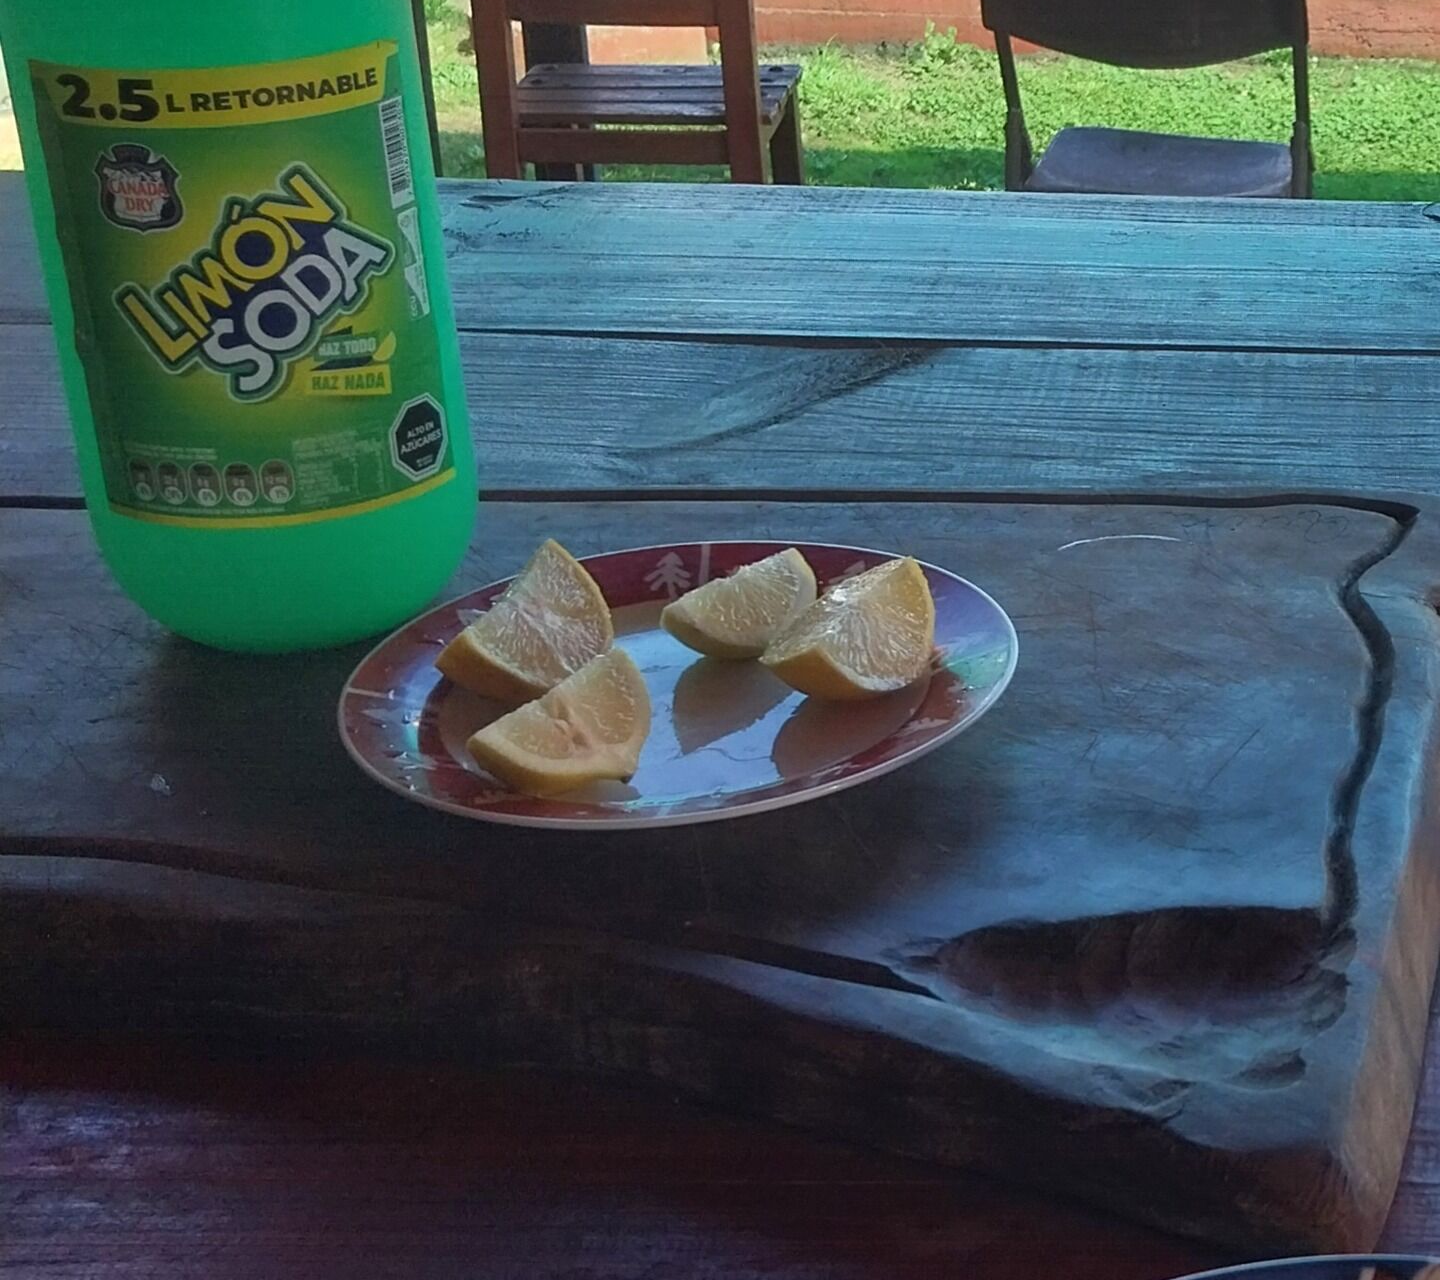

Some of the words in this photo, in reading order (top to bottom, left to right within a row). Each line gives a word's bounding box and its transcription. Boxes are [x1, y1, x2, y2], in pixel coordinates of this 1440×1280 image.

[55, 73, 161, 123] 2.5
[165, 93, 186, 114] L
[189, 67, 379, 113] RETORNABLE
[107, 178, 170, 197] CANADA
[124, 197, 155, 213] DRY
[123, 173, 336, 362] LIMÓN
[202, 226, 387, 392] SODA
[344, 336, 377, 356] TODO
[311, 374, 340, 391] HAZ
[344, 371, 386, 390] NADA
[407, 425, 425, 439] ALTO
